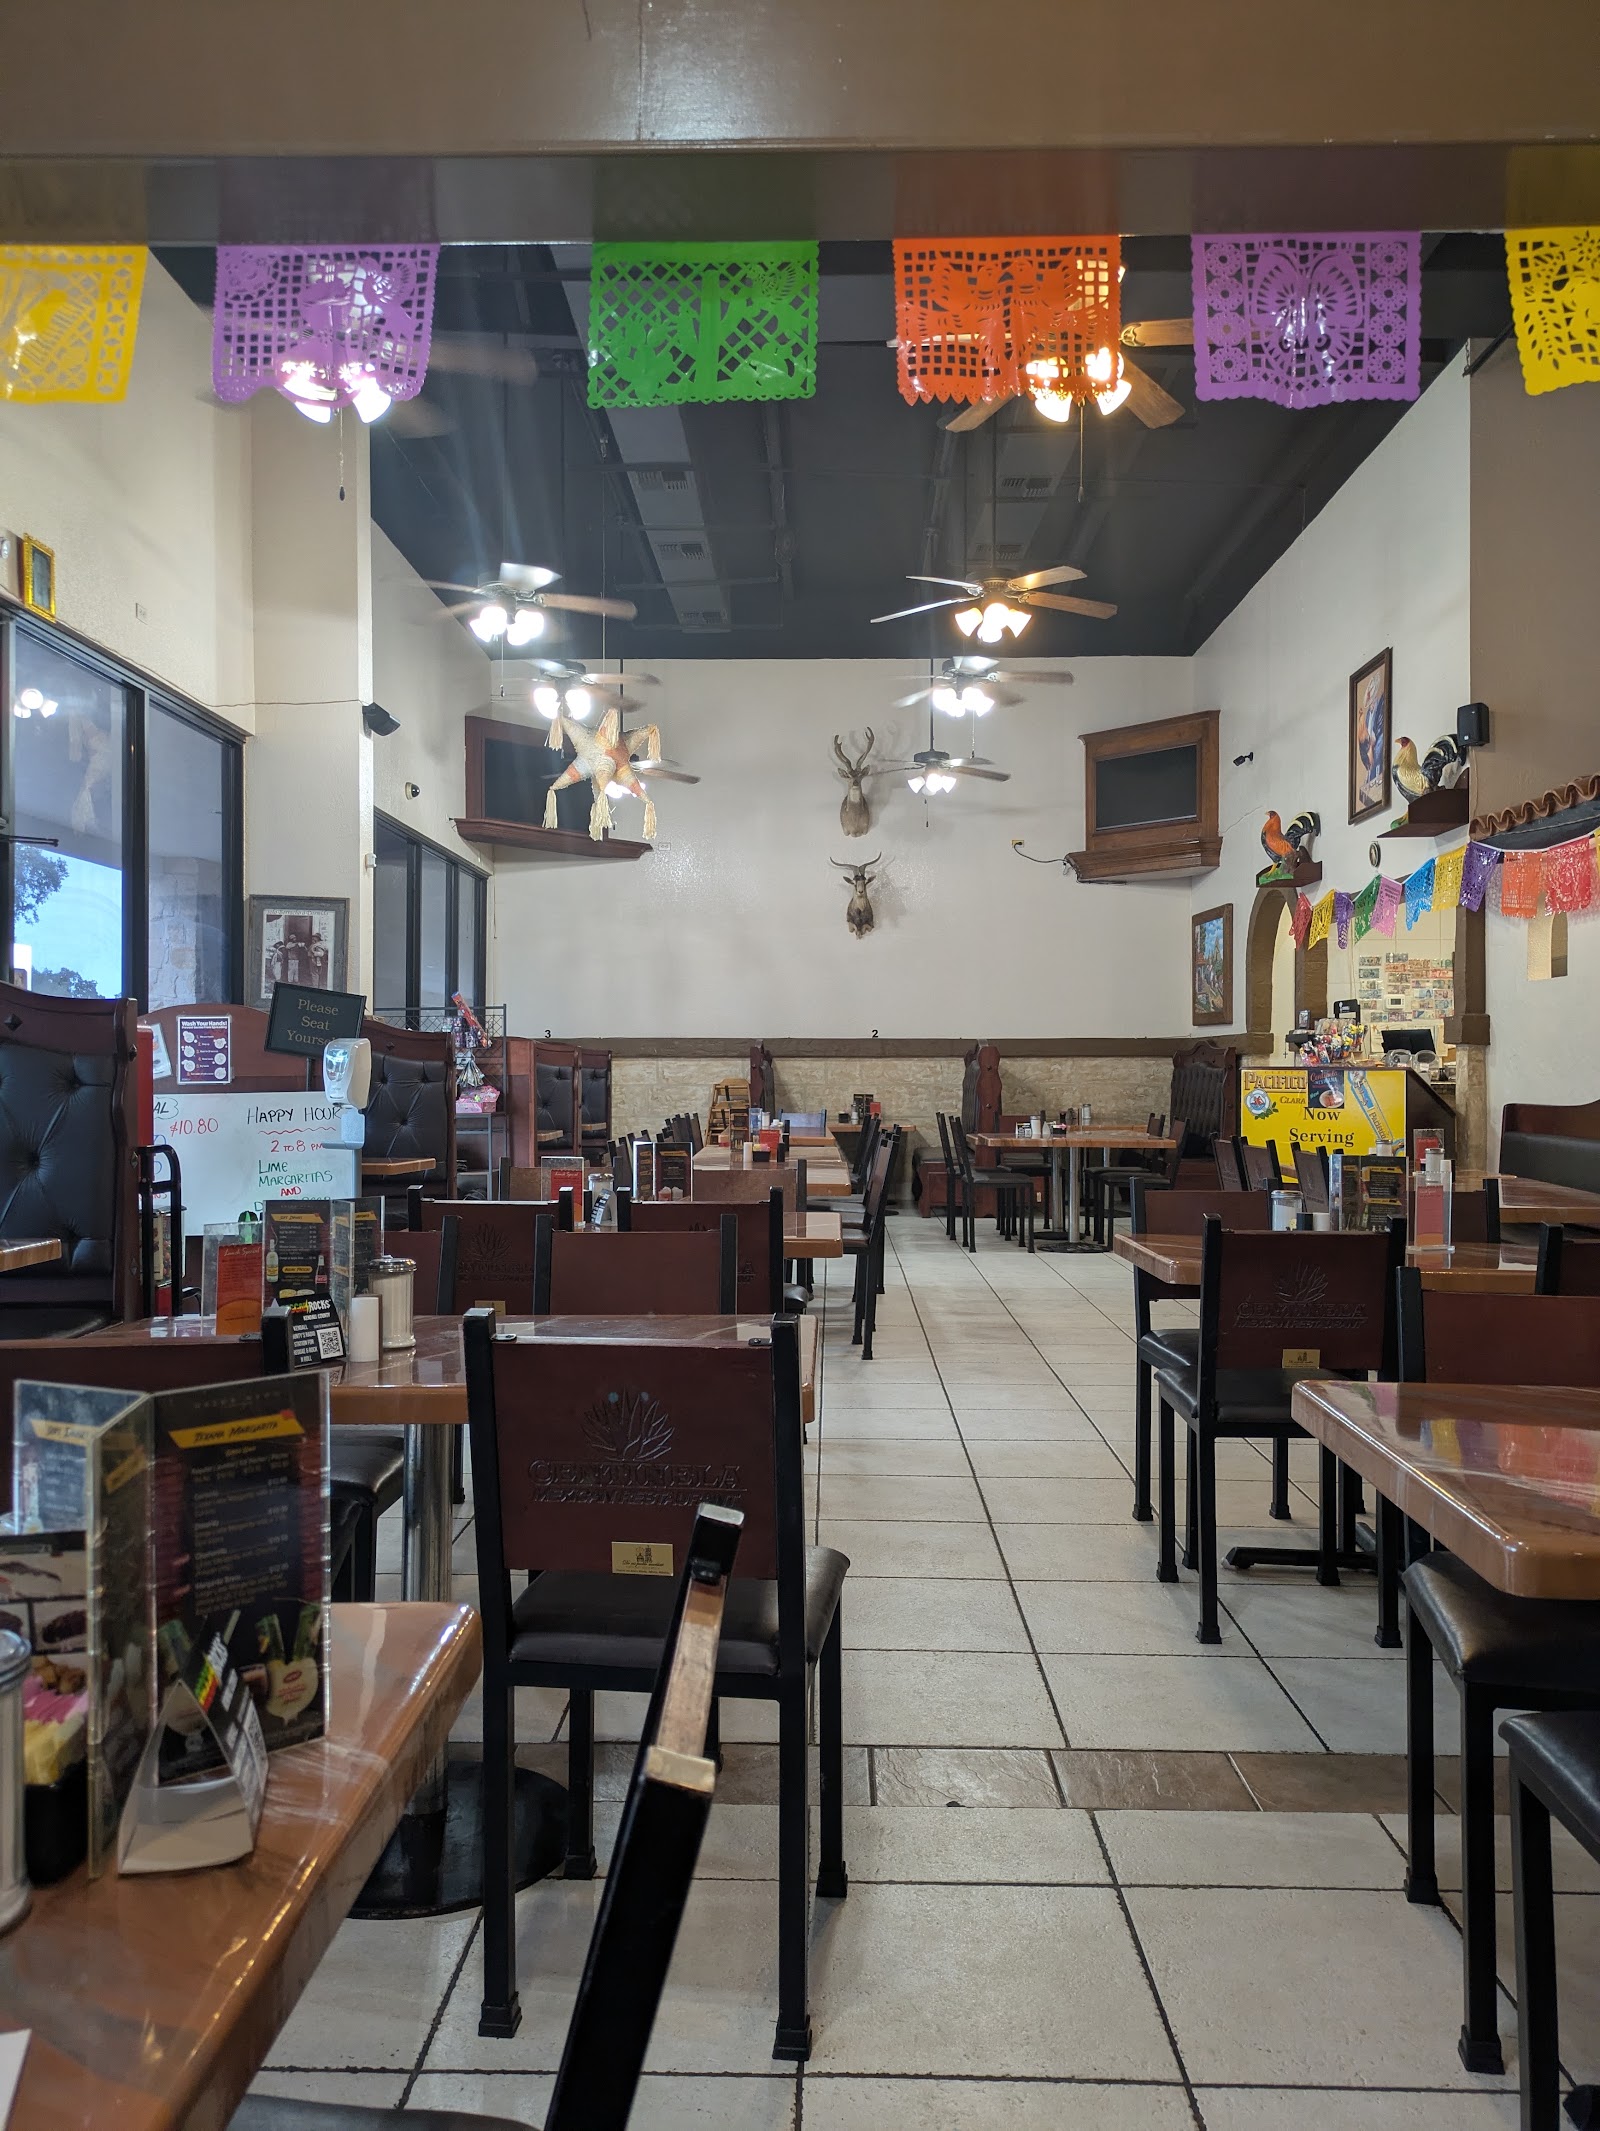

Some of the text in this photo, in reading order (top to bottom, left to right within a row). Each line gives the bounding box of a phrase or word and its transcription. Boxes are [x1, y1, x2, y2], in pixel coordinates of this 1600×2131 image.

[297, 998, 339, 1016] Please
[300, 1016, 330, 1031] Seat
[286, 1029, 337, 1046] Yourse
[544, 1029, 552, 1039] 3
[871, 1029, 879, 1038] 2
[1244, 1071, 1308, 1091] PACIFICO
[247, 1106, 342, 1125] HAPPY HOUR
[1303, 1107, 1341, 1121] Now
[170, 1118, 219, 1138] $10.80
[270, 1139, 280, 1152] 2
[296, 1139, 306, 1153] 8
[1289, 1128, 1355, 1148] Serving
[258, 1160, 288, 1175] LIME
[258, 1170, 333, 1187] MARGARITAS
[280, 1186, 302, 1197] AND
[527, 1459, 744, 1488] CENTINELA
